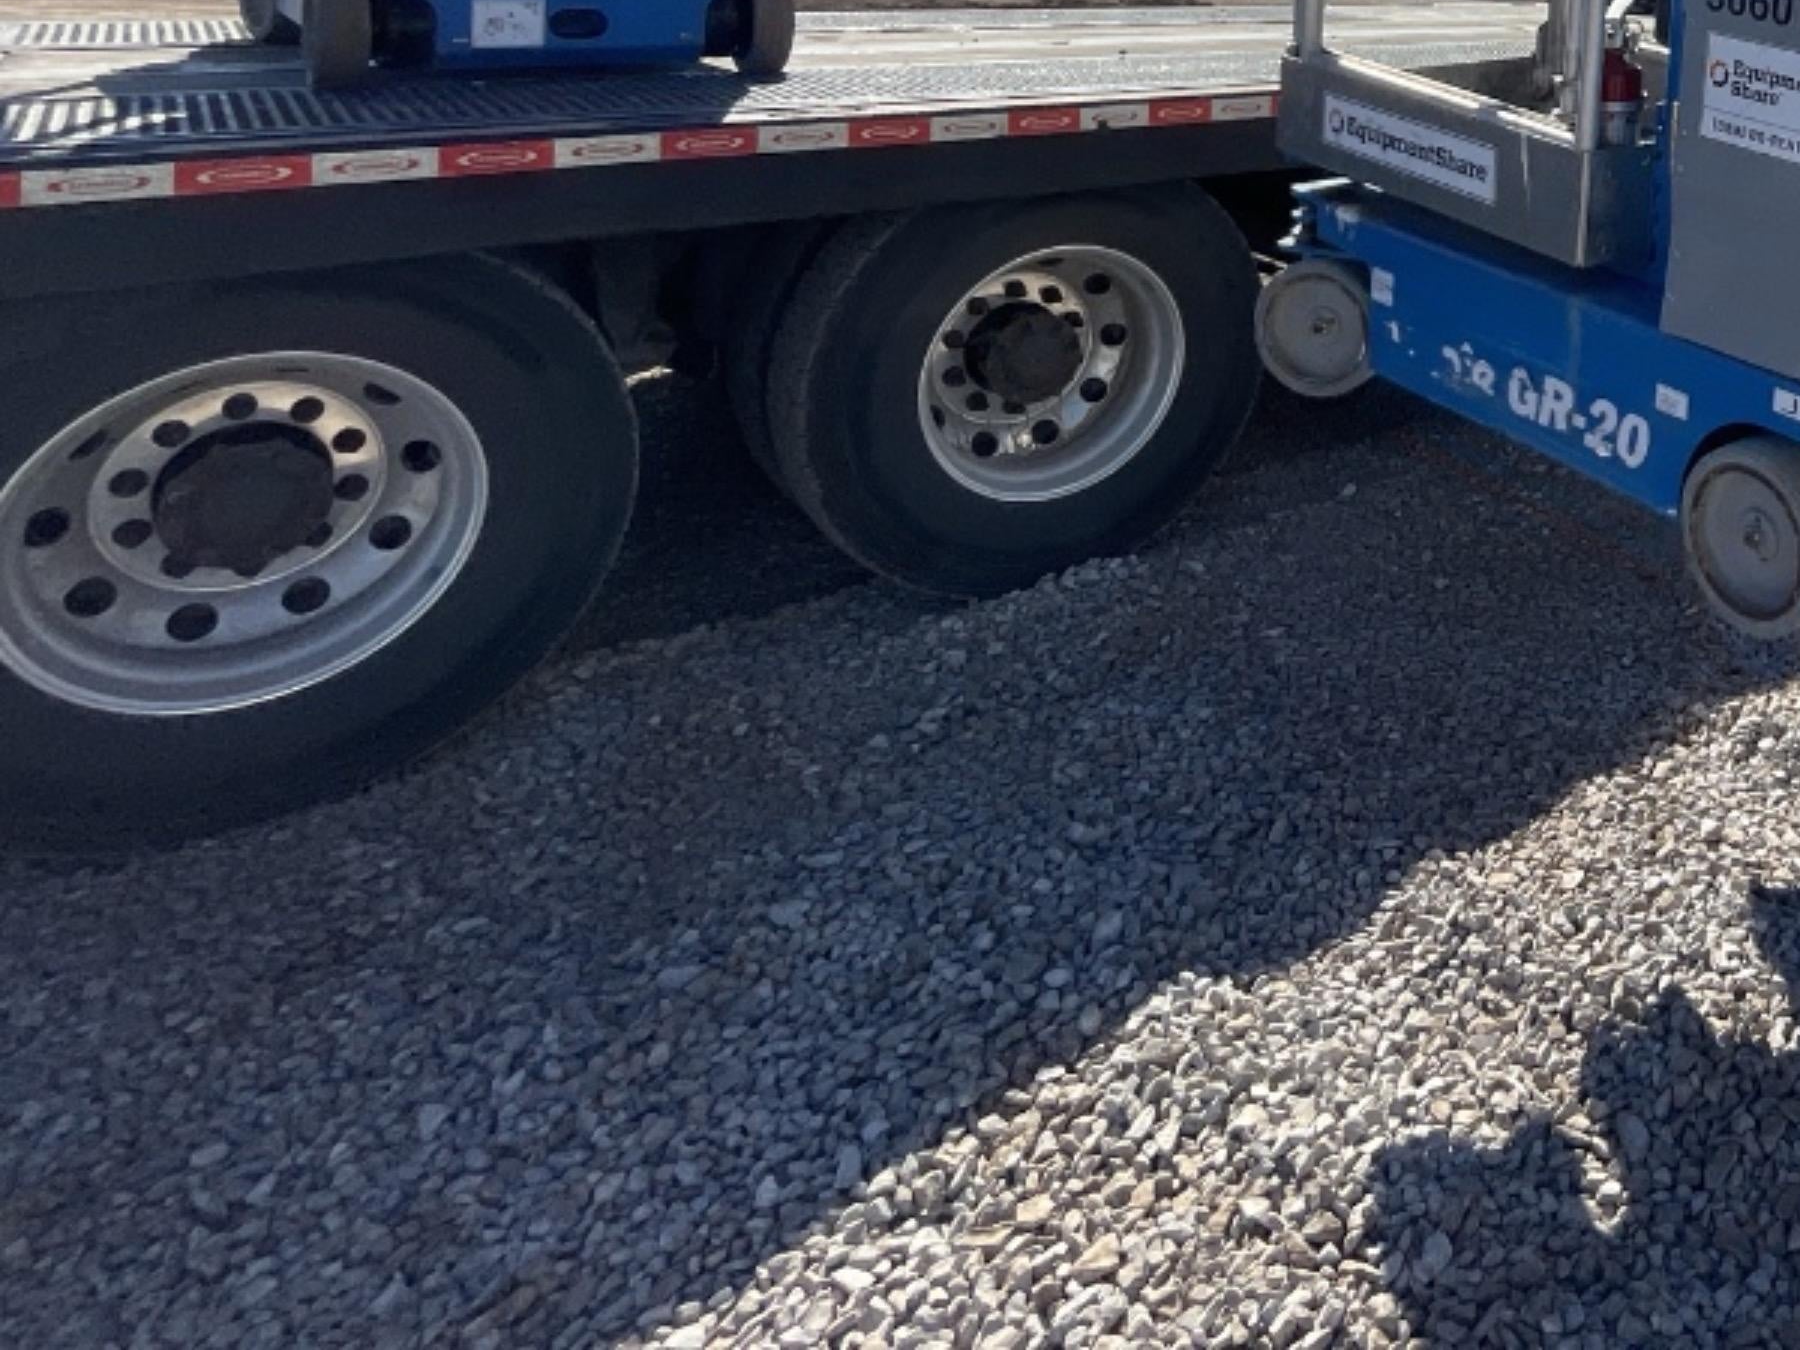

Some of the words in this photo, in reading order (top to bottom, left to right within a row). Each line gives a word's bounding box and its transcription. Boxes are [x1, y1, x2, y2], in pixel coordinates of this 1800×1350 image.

[1731, 81, 1781, 106] Share
[1346, 115, 1489, 184] EquipmentShare
[1507, 366, 1651, 468] GR-20
